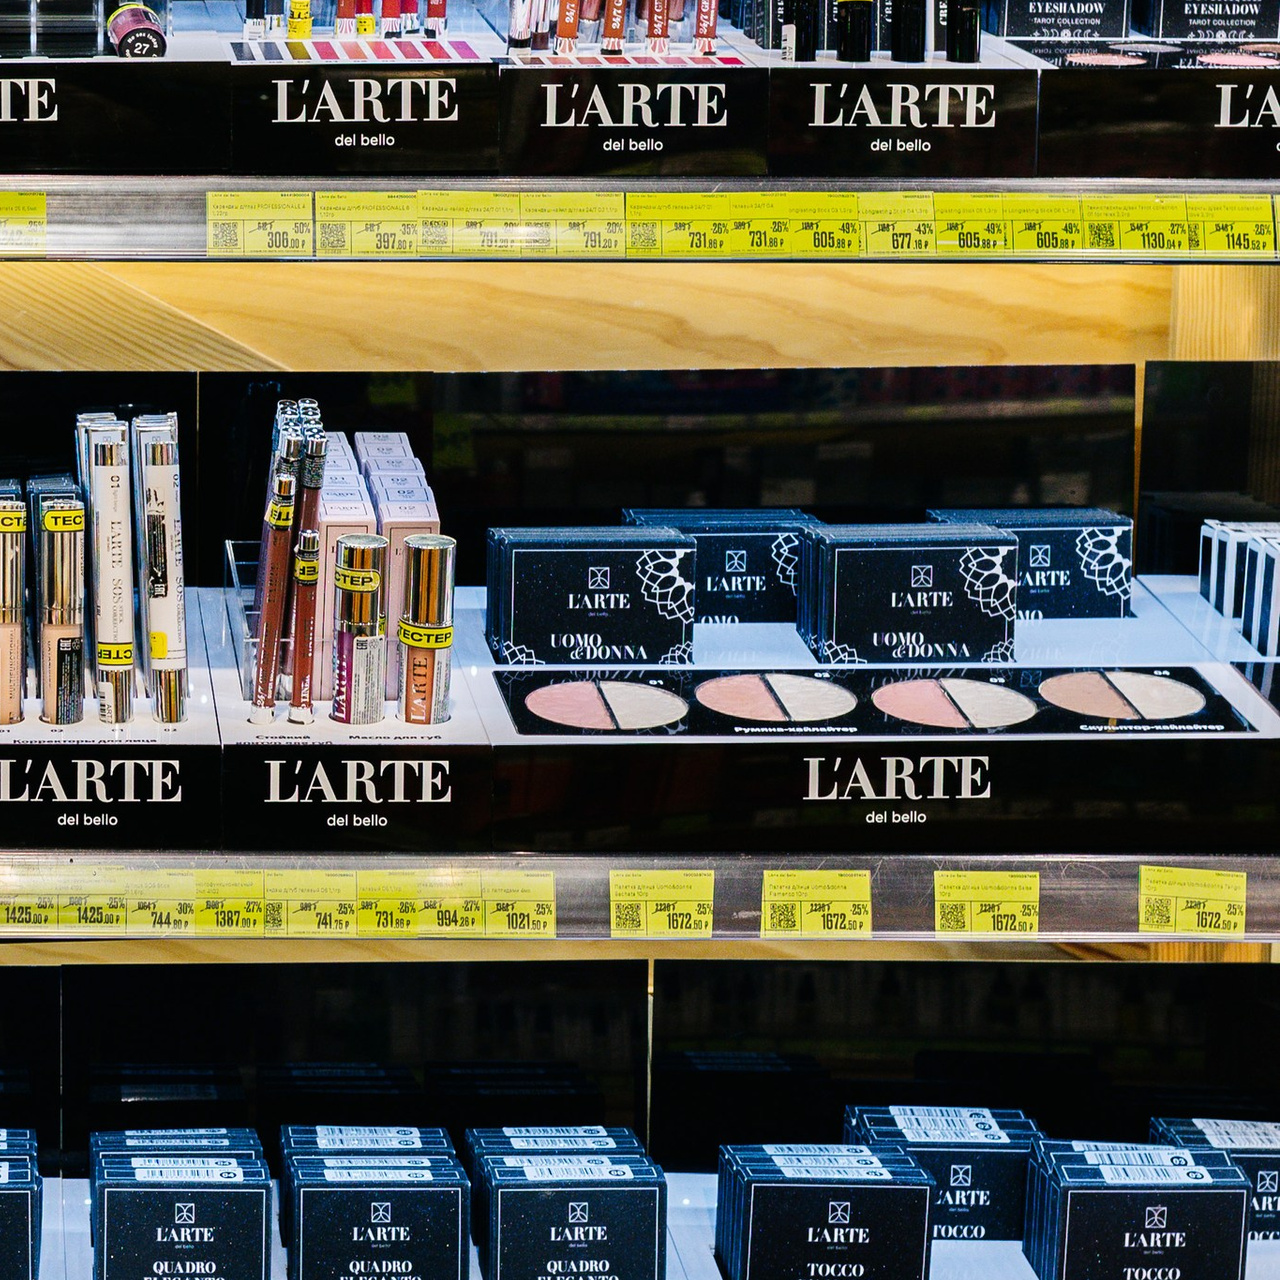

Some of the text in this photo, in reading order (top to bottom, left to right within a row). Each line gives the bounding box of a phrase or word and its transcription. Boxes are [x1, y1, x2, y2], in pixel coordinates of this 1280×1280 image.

[1029, 2, 1103, 13] EYESHADOW
[1057, 18, 1100, 27] COLLECTION
[272, 78, 458, 123] L'ARTE
[540, 84, 727, 127] L'ARTE
[808, 83, 996, 128] L'ARTE
[871, 632, 925, 649] UOMO
[264, 760, 451, 803] L'ARTE
[803, 756, 991, 800] L'ARTE
[866, 811, 926, 823] del bello
[807, 1263, 864, 1277] TOCCO
